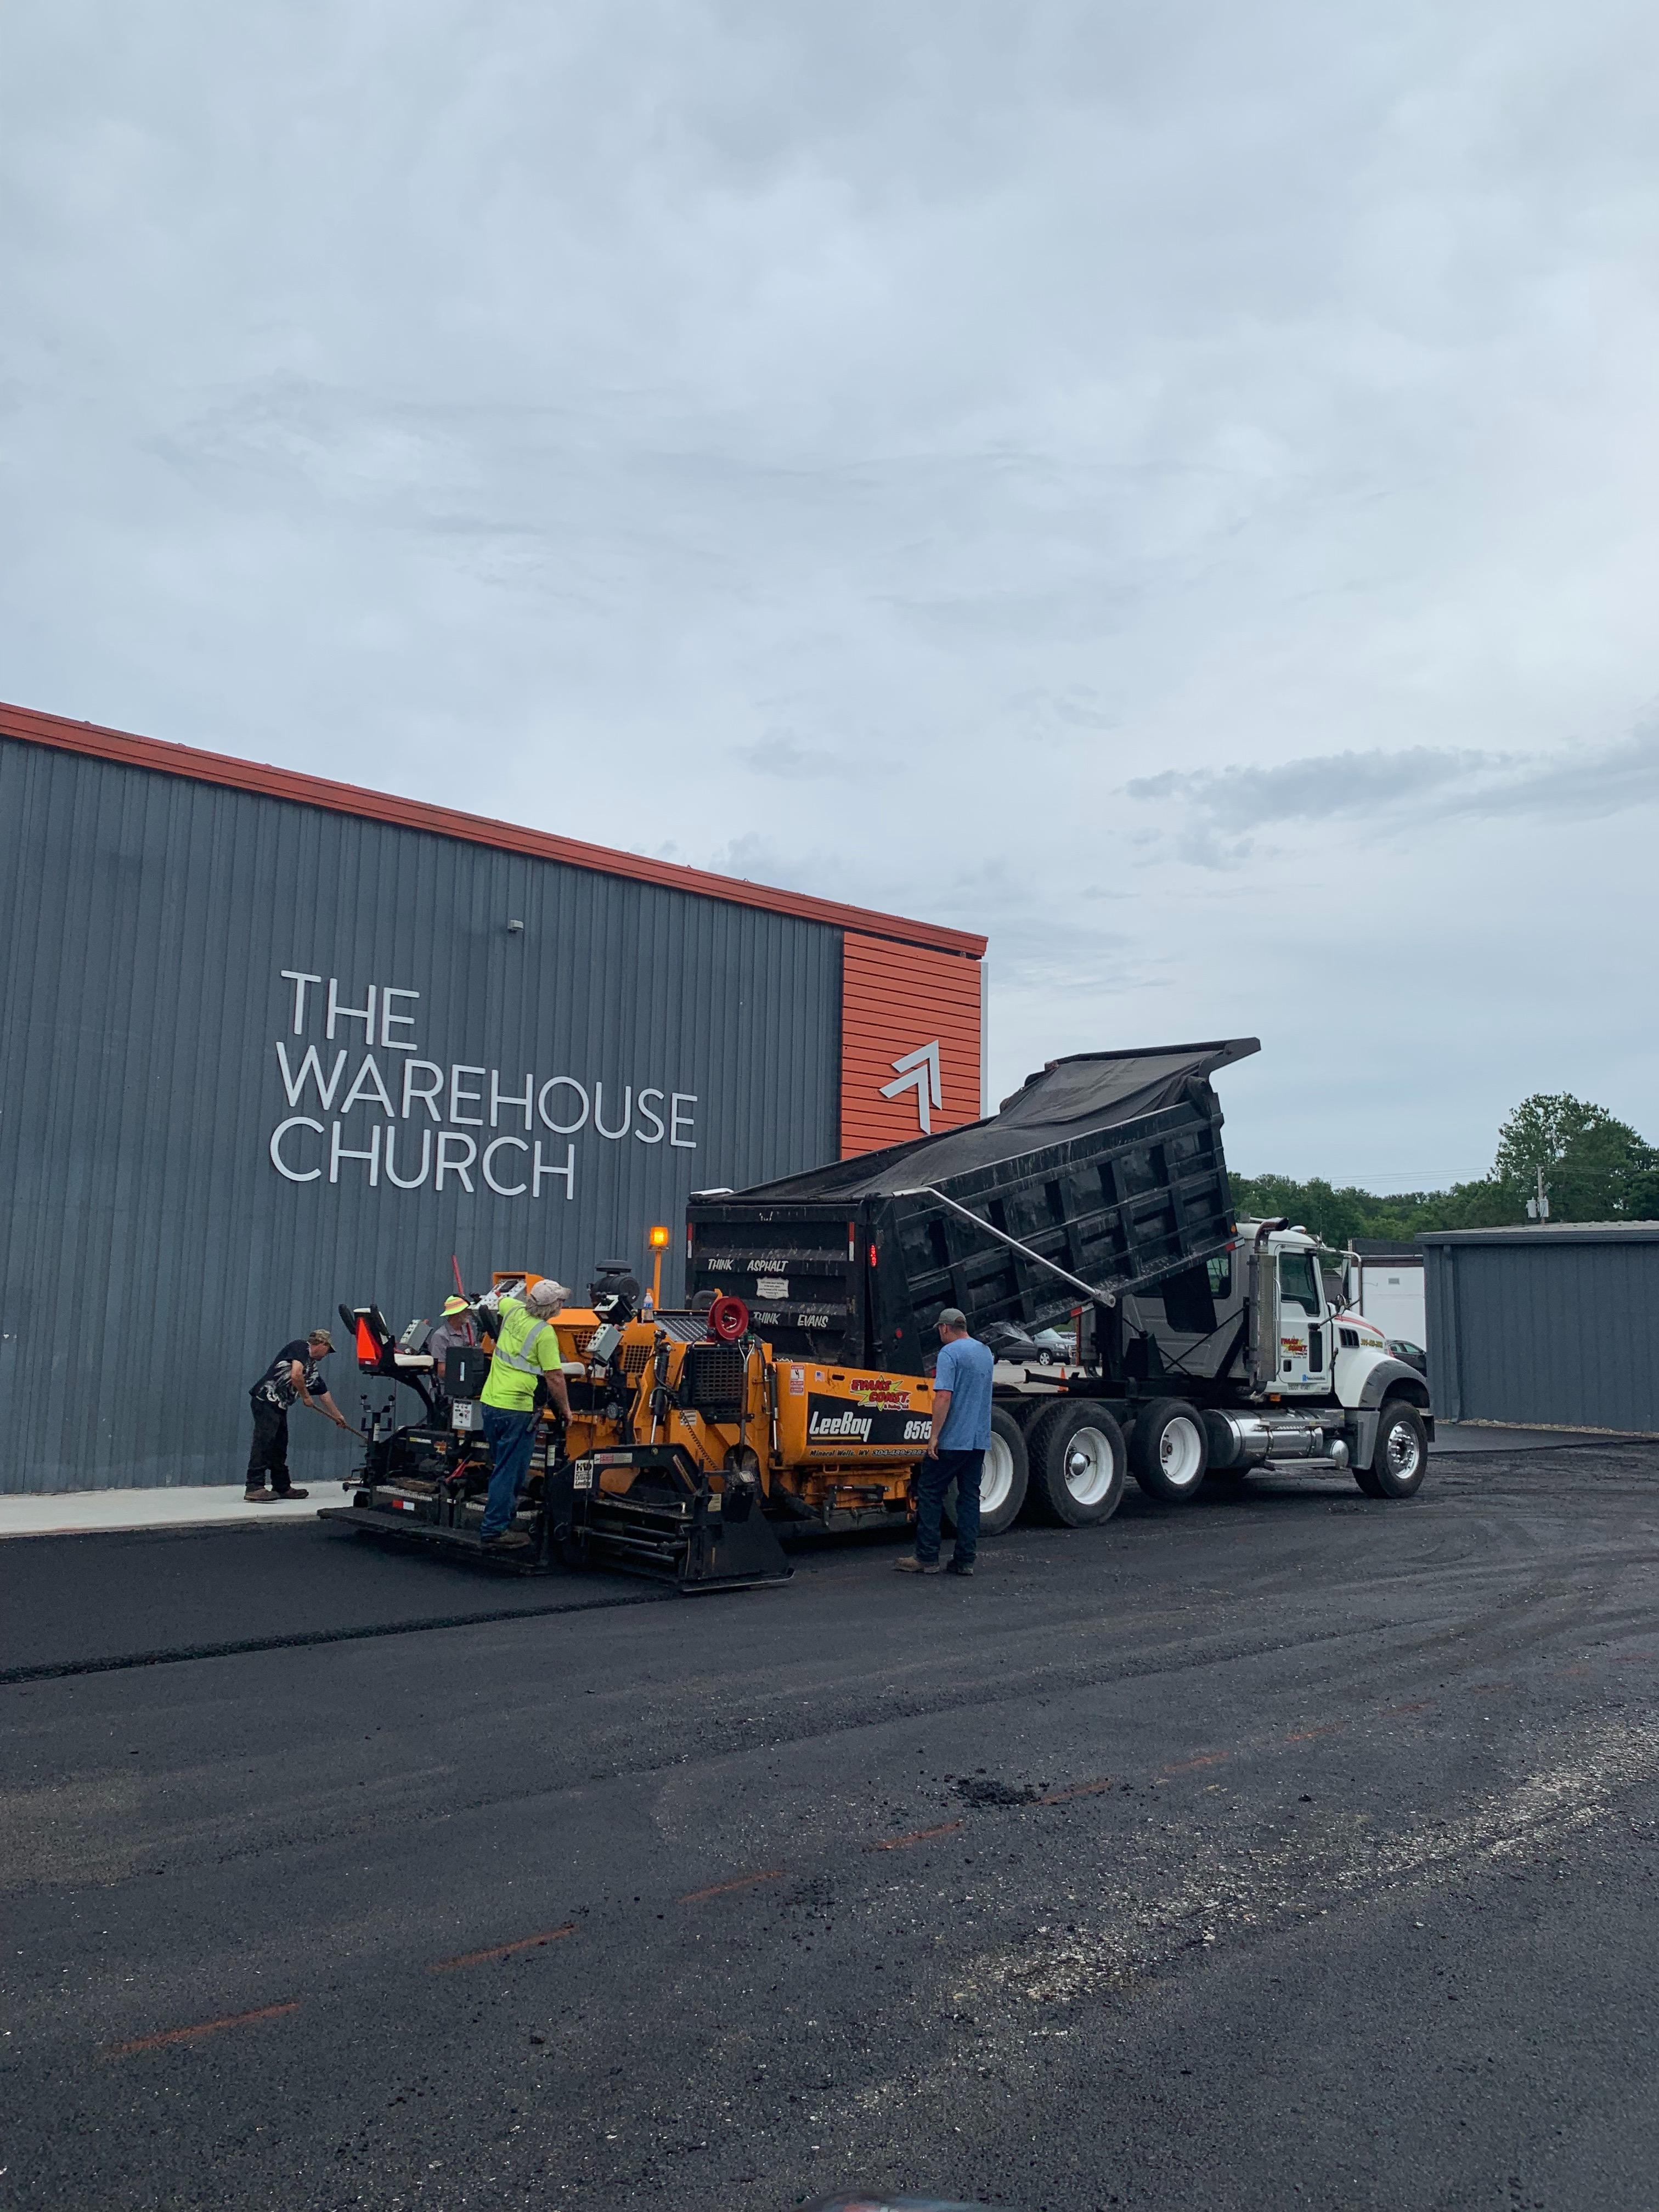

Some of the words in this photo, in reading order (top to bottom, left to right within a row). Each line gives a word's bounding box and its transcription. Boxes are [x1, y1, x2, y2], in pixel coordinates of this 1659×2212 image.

[280, 969, 420, 1051] THE
[276, 1041, 698, 1148] WAREHOUSE
[270, 1116, 575, 1200] CHURCH
[708, 1259, 734, 1271] THINK
[747, 1259, 788, 1272] ASPHALT
[754, 1311, 781, 1325] THINK
[797, 1314, 829, 1328] EVANS
[851, 1380, 891, 1390] EVANS
[869, 1391, 911, 1403] CONST.
[809, 1411, 872, 1442] LeeBoy
[904, 1420, 932, 1440] 8515
